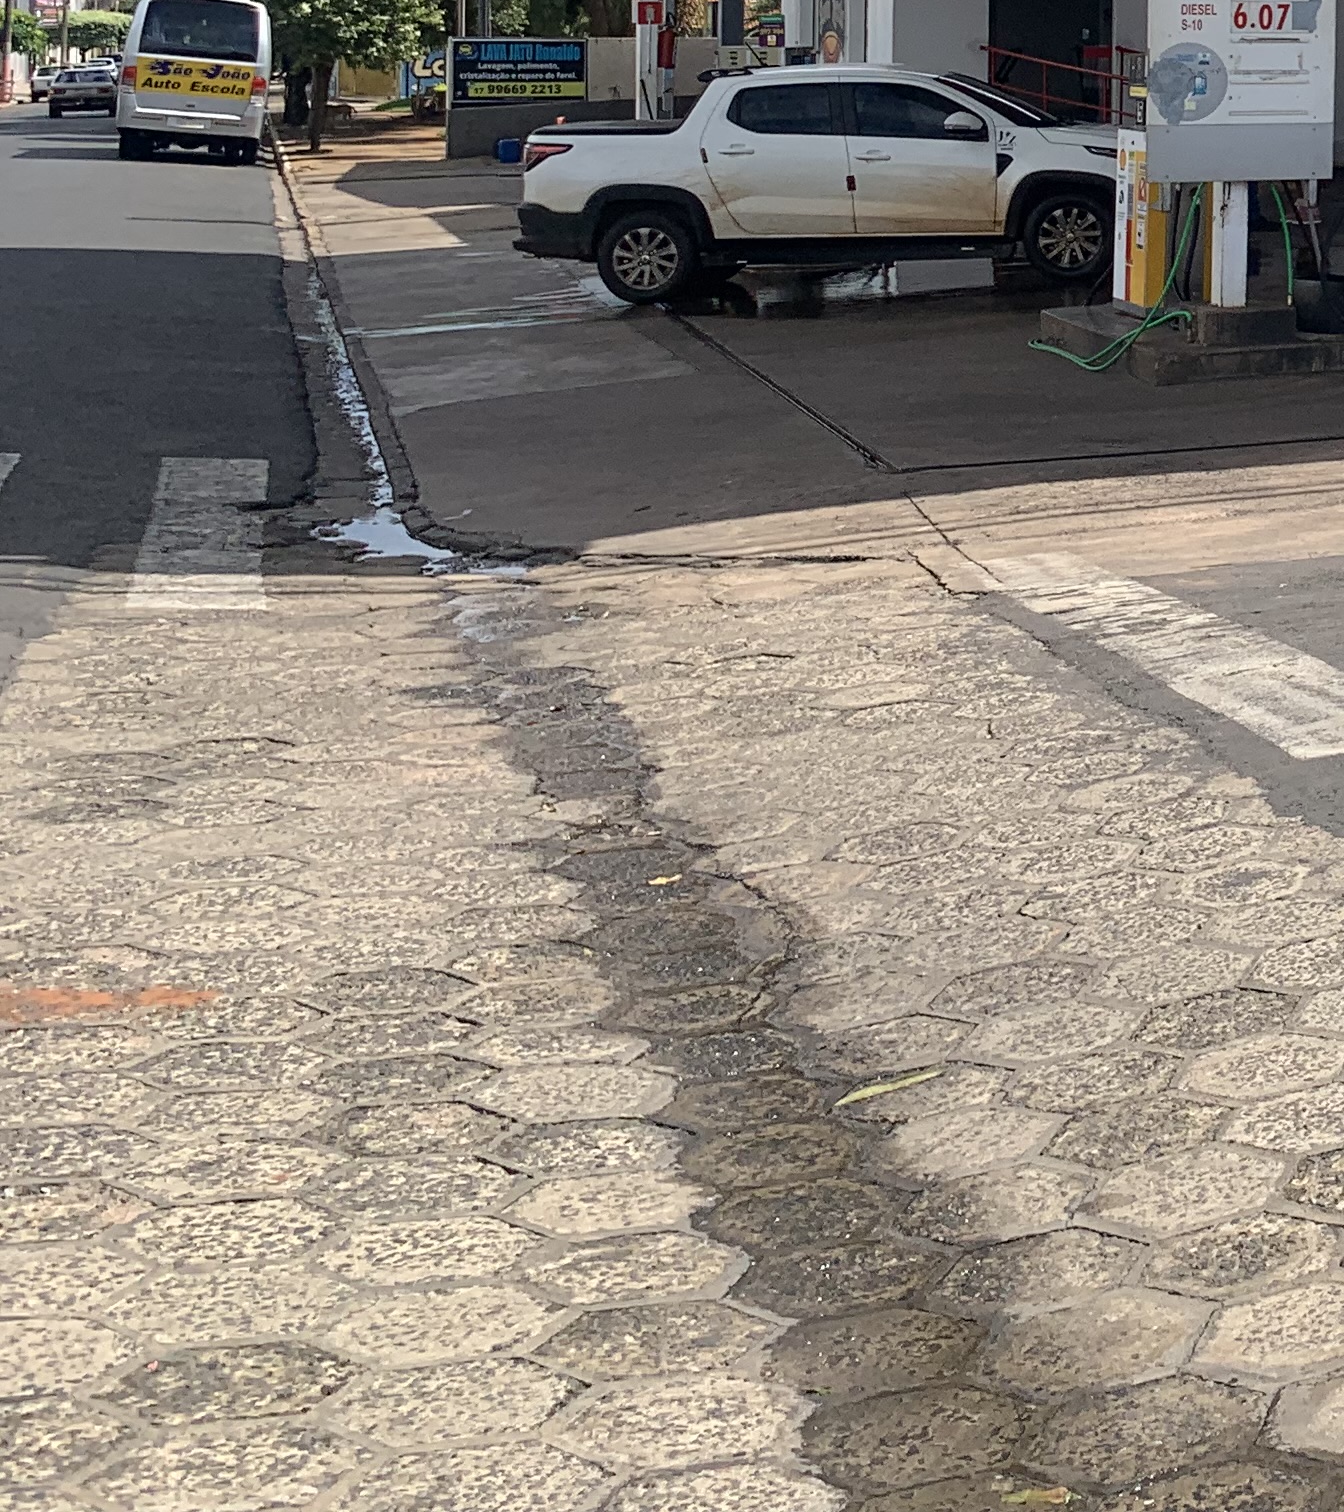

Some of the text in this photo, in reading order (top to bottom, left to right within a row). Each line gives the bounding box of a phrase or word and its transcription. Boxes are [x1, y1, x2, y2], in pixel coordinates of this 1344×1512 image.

[1181, 3, 1217, 16] DIESEL
[1233, 2, 1291, 30] 6.07
[1181, 19, 1203, 31] S-10
[481, 44, 506, 61] LAVA
[148, 59, 251, 81] São João
[141, 77, 246, 96] Auto Escola
[487, 84, 527, 95] 99669
[530, 84, 562, 95] 2213
